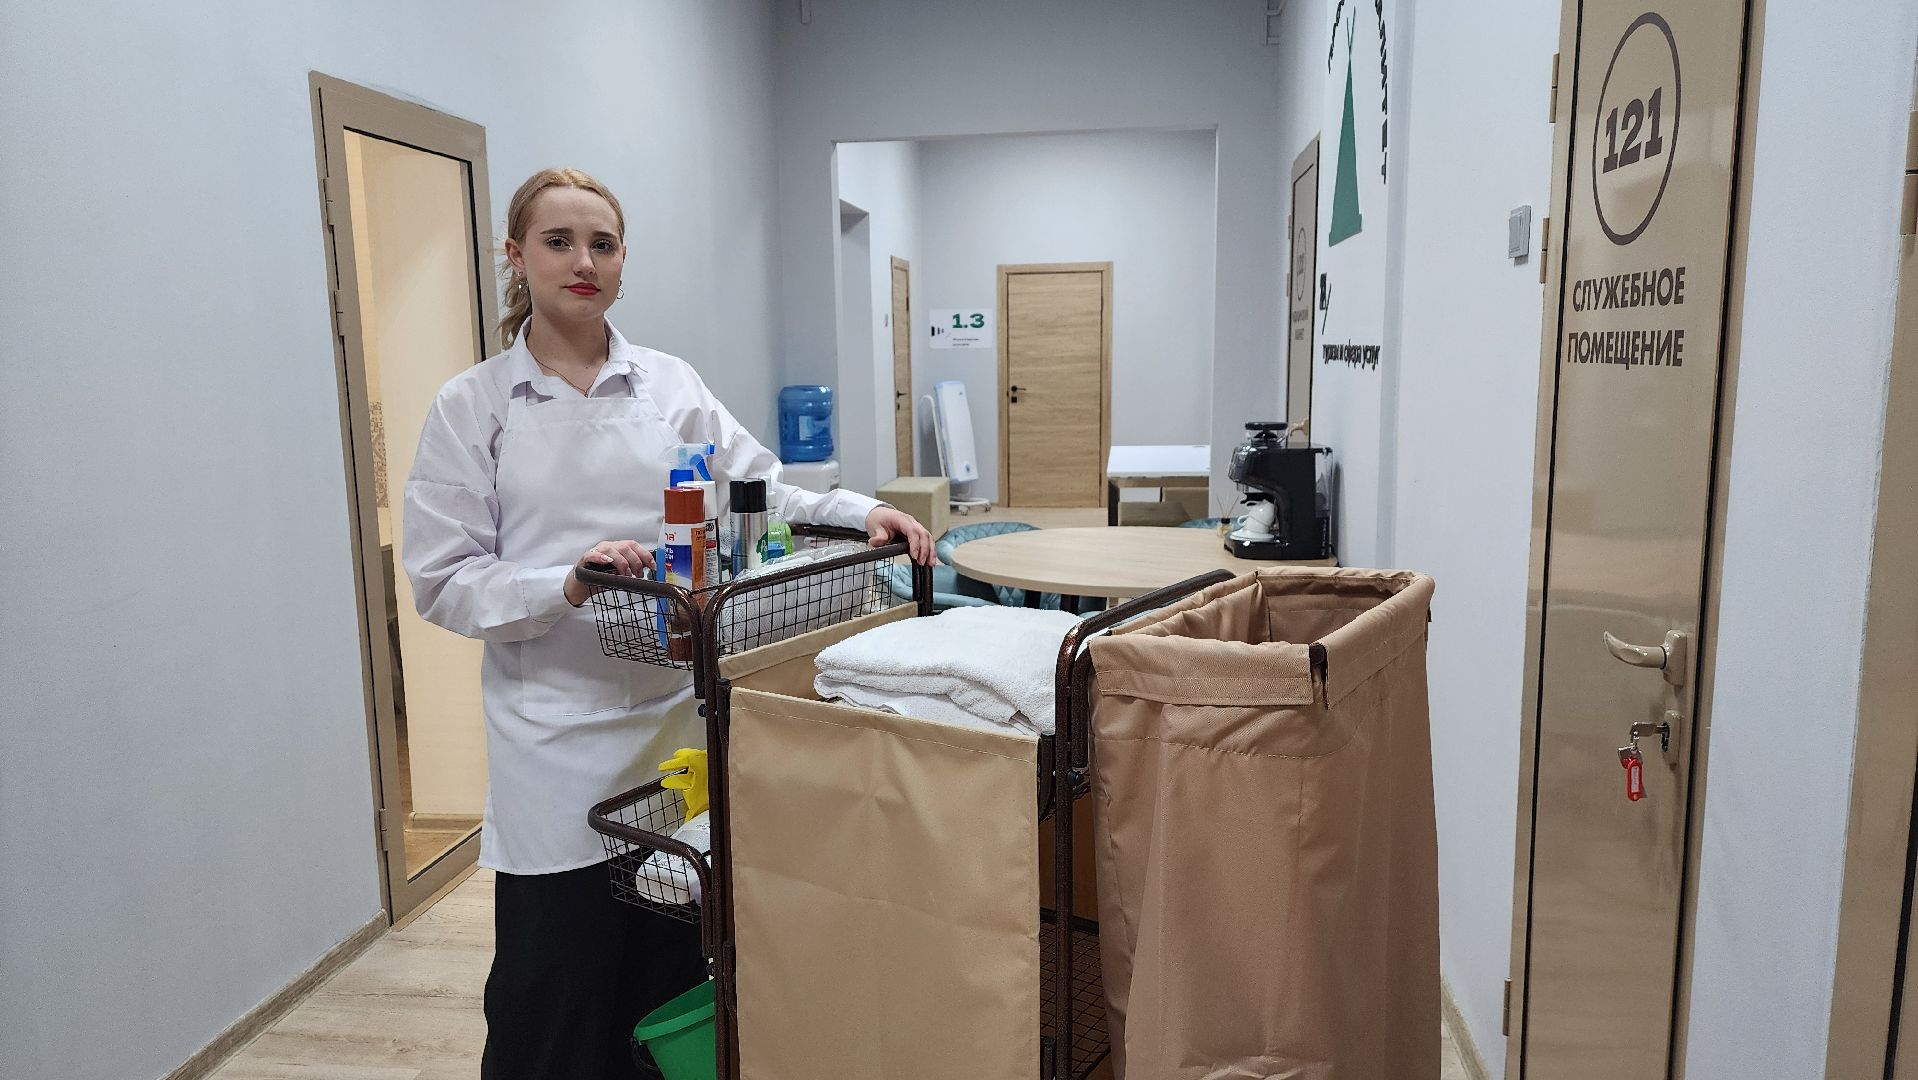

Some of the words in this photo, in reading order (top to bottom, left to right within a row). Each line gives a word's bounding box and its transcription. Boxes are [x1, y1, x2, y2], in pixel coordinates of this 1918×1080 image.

[1602, 87, 1663, 174] 121
[1572, 266, 1686, 312] СЛУЖЕБНОЕ
[952, 313, 985, 328] 1.3
[1567, 329, 1685, 370] ПОМЕЩЕНИЕ
